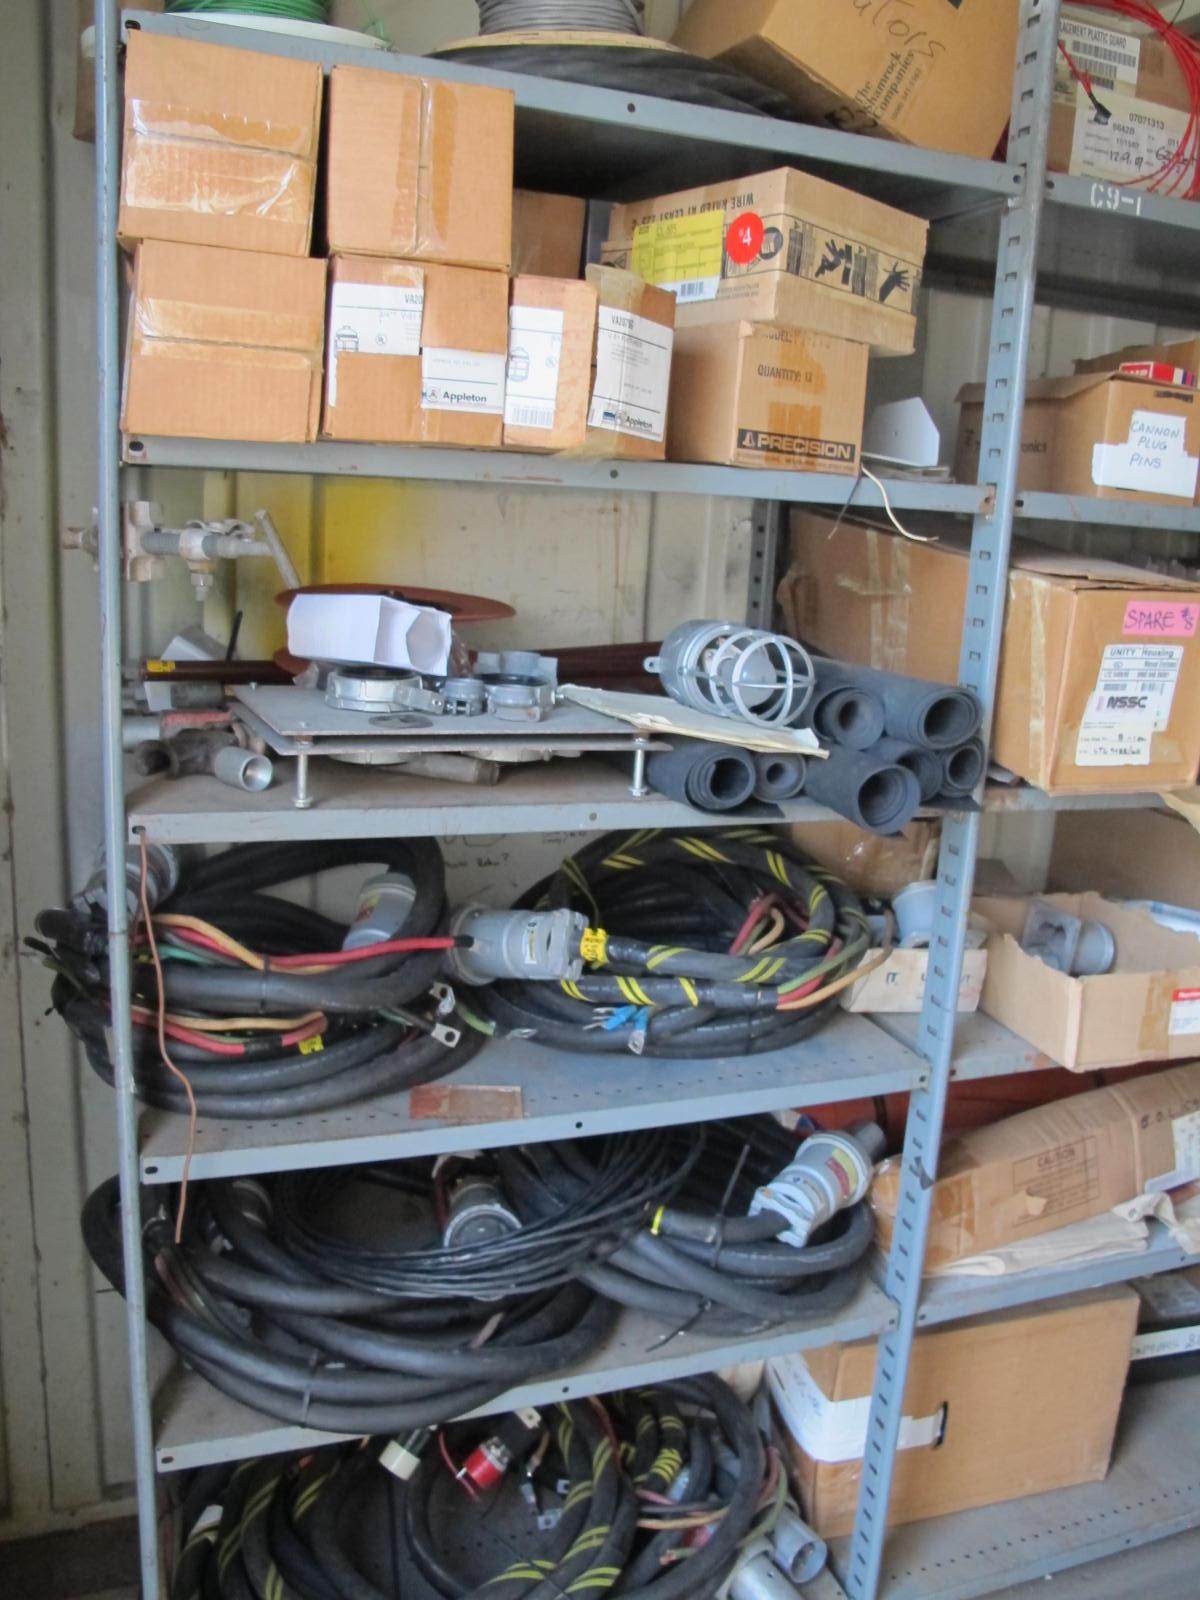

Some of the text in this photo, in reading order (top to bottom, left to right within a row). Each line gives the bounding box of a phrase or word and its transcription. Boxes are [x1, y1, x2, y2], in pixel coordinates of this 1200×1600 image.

[1058, 20, 1127, 49] LACEMENT PLASTIC GUARD
[863, 51, 902, 113] Shamrock
[872, 49, 915, 120] Companies
[854, 81, 873, 105] The
[731, 192, 754, 210] WIRE
[1090, 183, 1142, 216] C9-1
[404, 293, 423, 305] VA20
[442, 391, 488, 404] Appleton
[625, 415, 654, 431] Appleton
[1130, 420, 1180, 439] CANNON
[757, 433, 852, 460] PRECISION
[1137, 437, 1168, 451] PLUG
[1129, 454, 1162, 469] PINS
[1124, 609, 1175, 631] SPARE
[1110, 648, 1175, 659] UNITY Housing
[1106, 696, 1149, 709] NSSC
